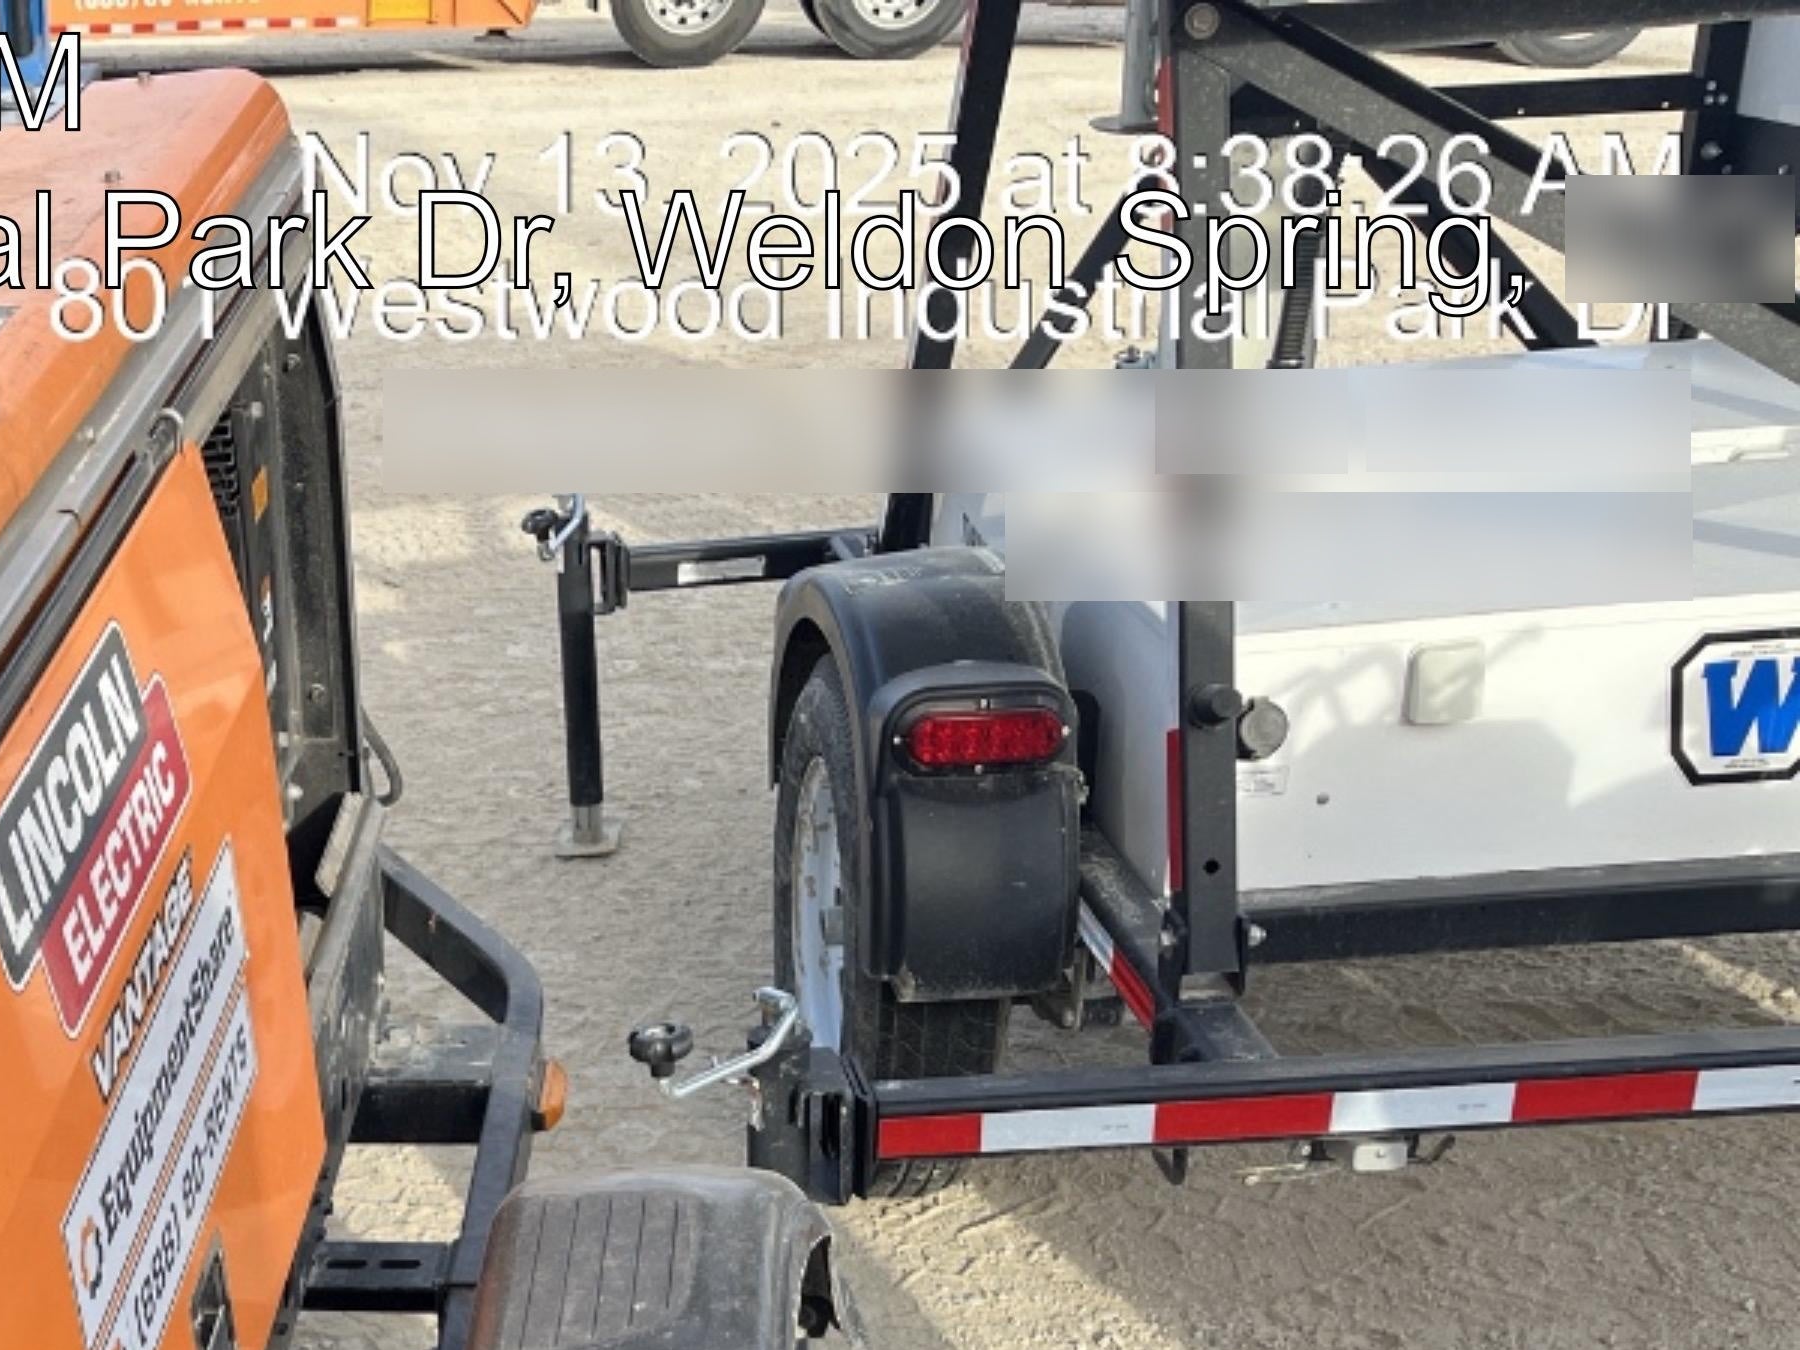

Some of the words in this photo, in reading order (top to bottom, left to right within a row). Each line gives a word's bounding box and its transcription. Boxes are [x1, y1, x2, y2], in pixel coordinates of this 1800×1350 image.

[61, 740, 177, 986] ELECTRIC
[91, 850, 193, 1099] VANTAGE
[100, 905, 235, 1247] EquipmentShare
